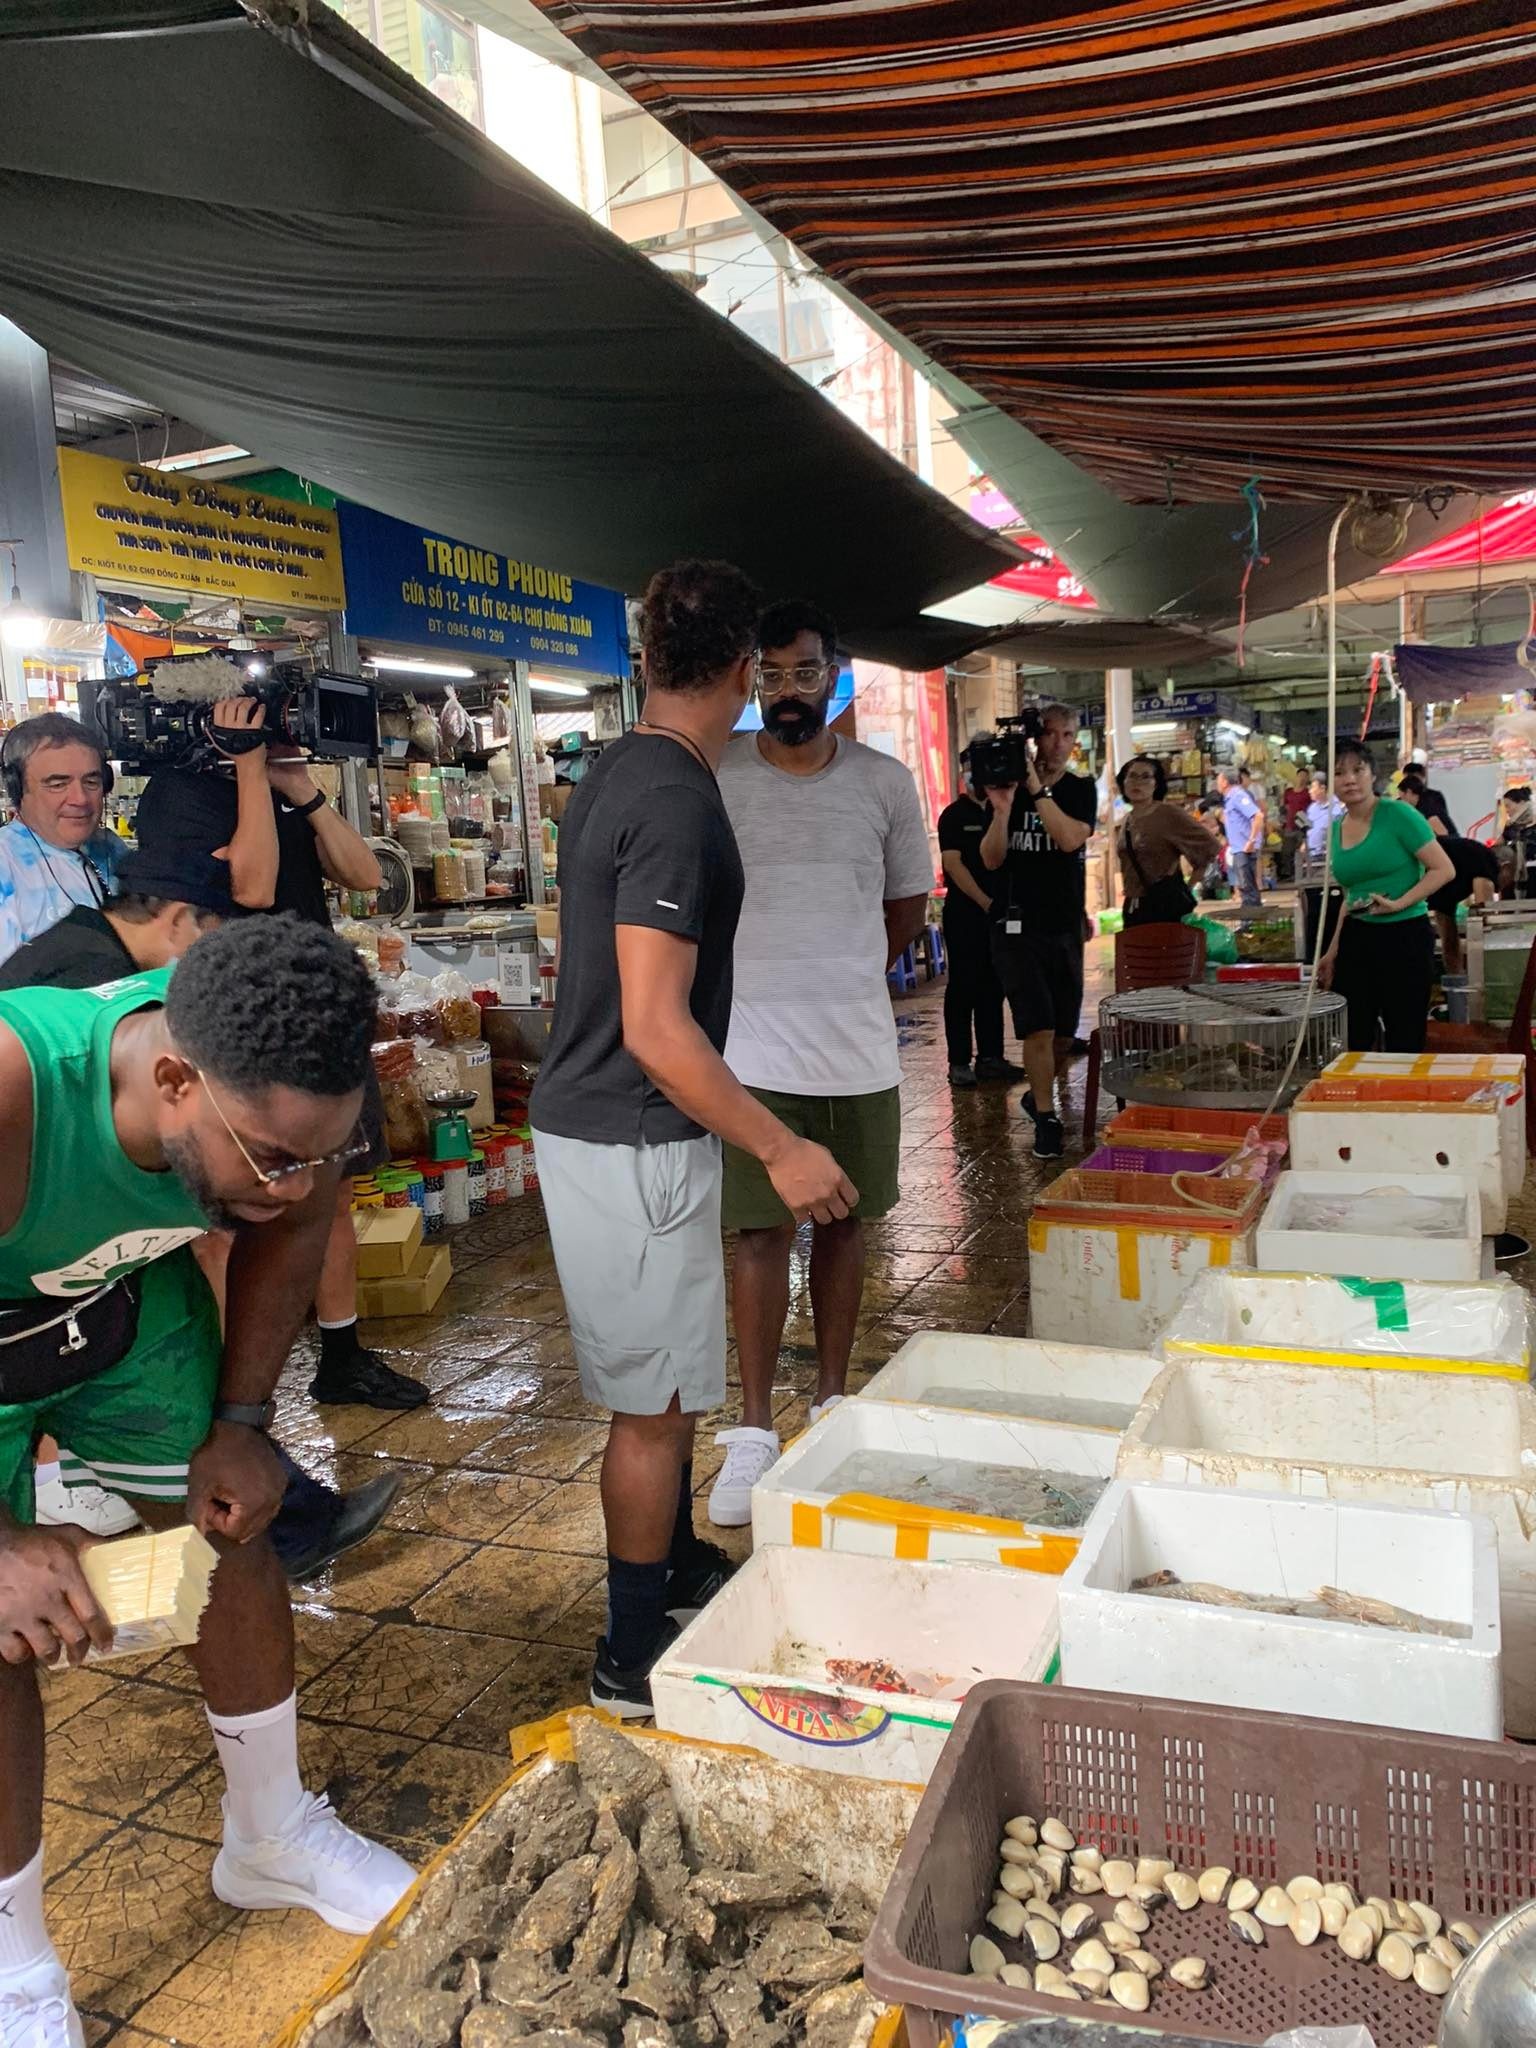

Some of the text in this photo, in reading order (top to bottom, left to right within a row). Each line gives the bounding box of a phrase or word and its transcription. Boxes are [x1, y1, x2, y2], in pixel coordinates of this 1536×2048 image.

[423, 537, 573, 605] TRỌNG PHONG
[402, 576, 426, 607] CỬA
[428, 581, 444, 611] SỐ
[446, 591, 460, 613] 12
[481, 591, 495, 617] ỐT
[496, 600, 523, 623] 62-64
[525, 606, 543, 633] CHỢ
[569, 614, 593, 639] XUÂN
[428, 618, 445, 635] ĐT:
[447, 620, 470, 637] 0945
[471, 625, 487, 641] 461
[489, 629, 505, 644] 299
[530, 636, 550, 652] 0904
